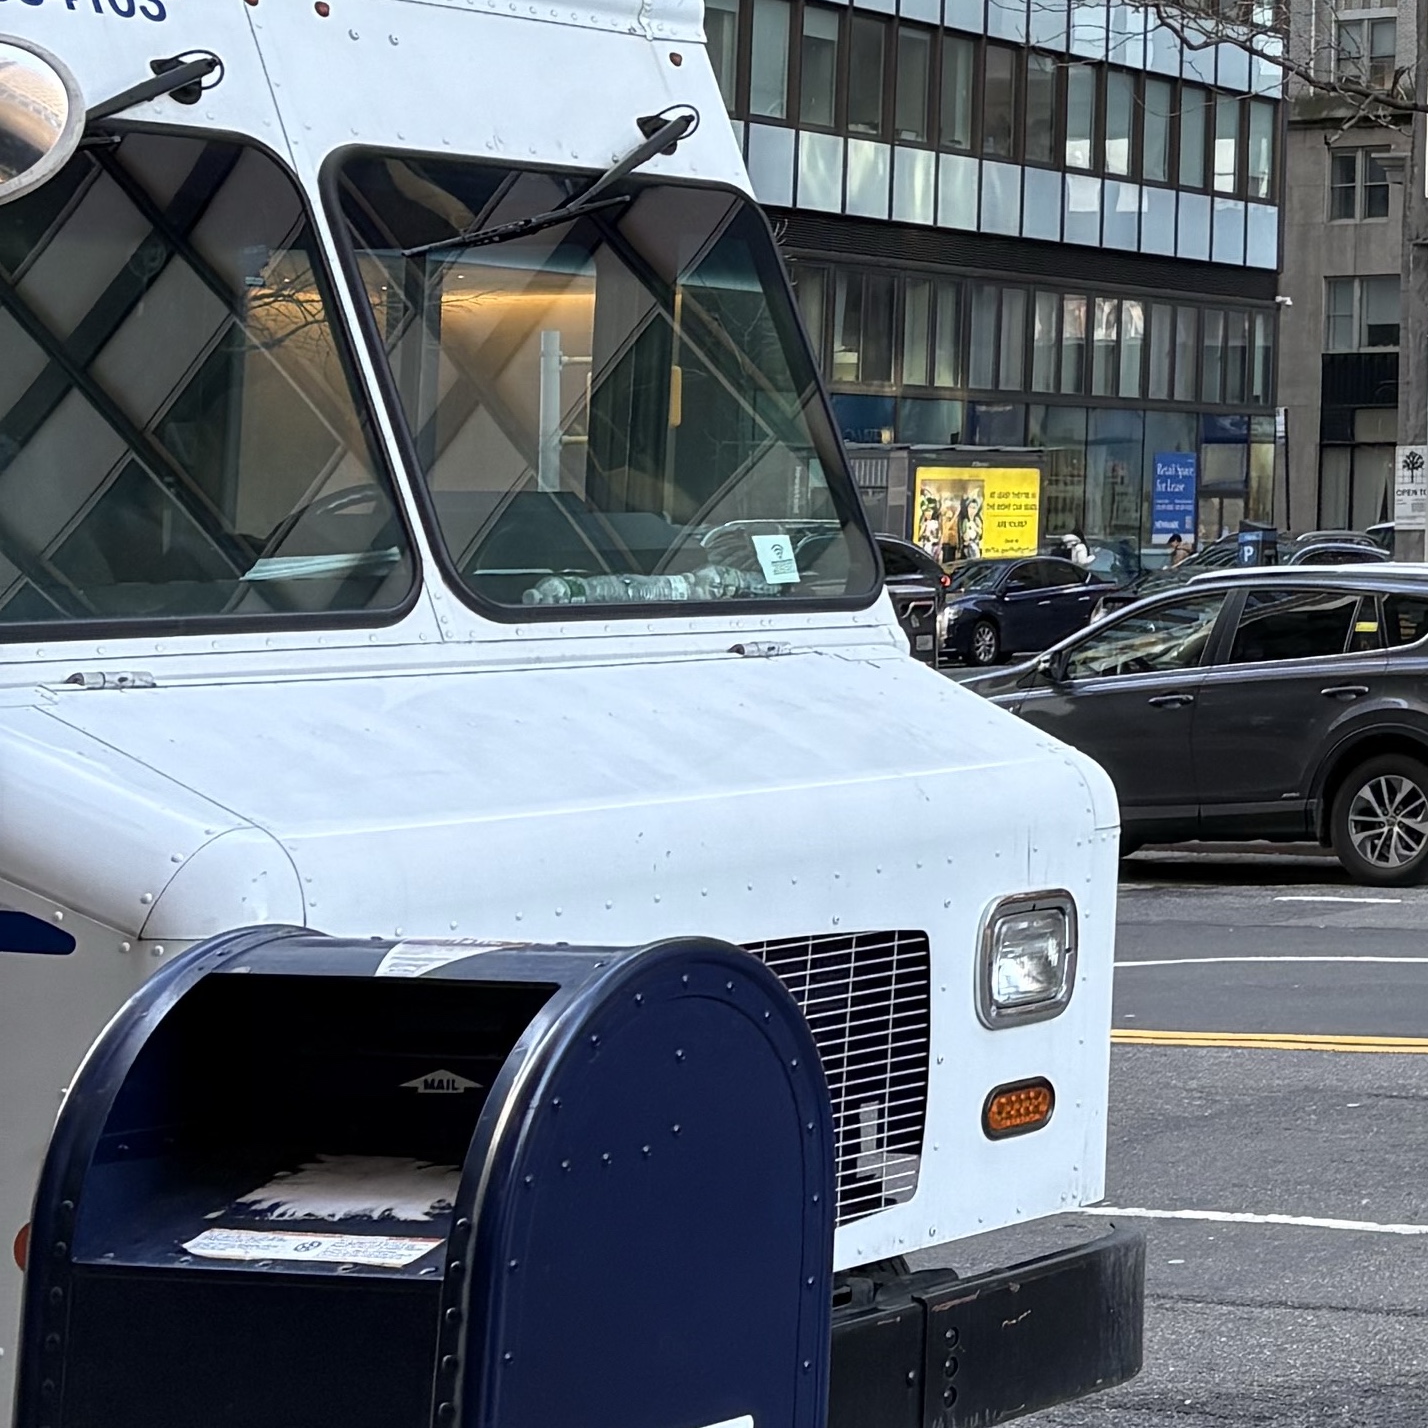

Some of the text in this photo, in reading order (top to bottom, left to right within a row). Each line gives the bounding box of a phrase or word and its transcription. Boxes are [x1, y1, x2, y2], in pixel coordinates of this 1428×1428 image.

[1396, 489, 1418, 497] OPEN
[1243, 545, 1254, 562] P
[424, 1077, 459, 1092] MAIL
